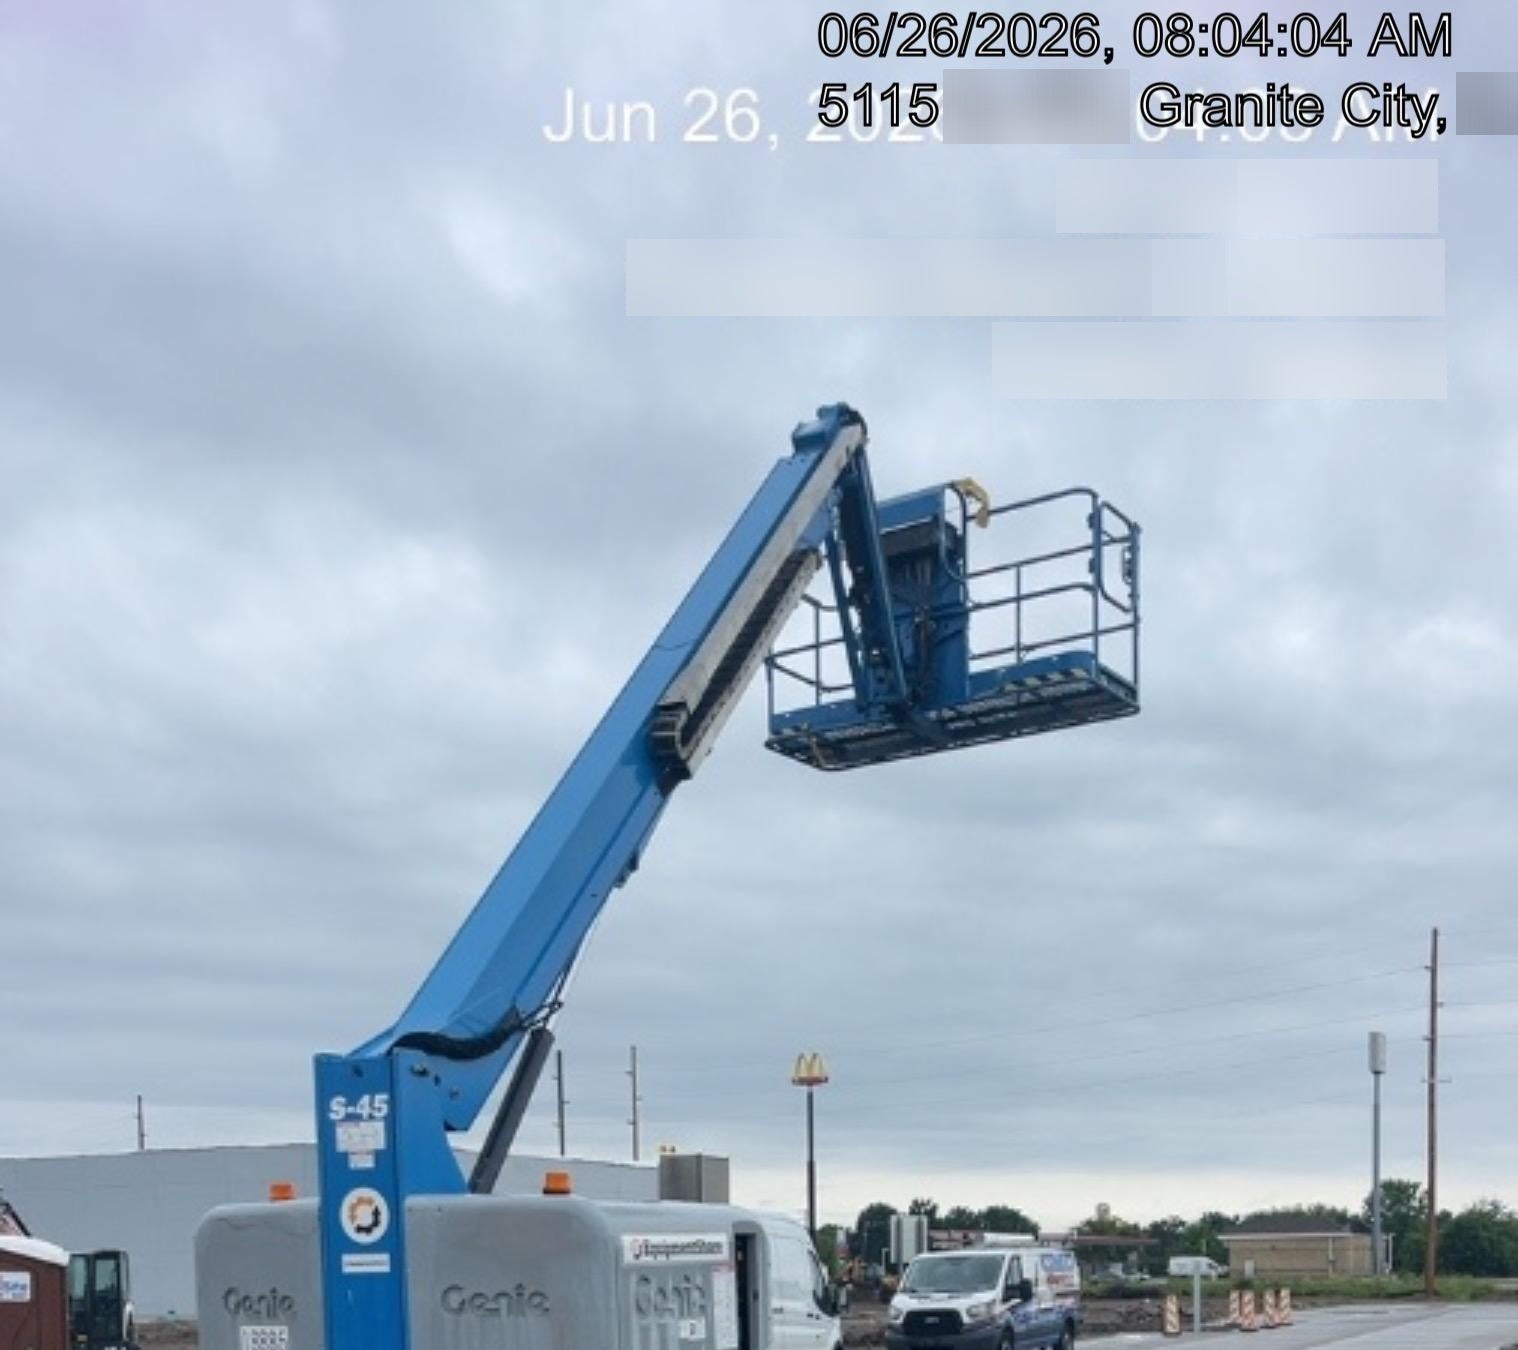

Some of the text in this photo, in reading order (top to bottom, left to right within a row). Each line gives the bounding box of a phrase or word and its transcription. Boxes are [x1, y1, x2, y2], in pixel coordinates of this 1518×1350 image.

[328, 1093, 390, 1121] S-45
[222, 1286, 297, 1318] Genie
[441, 1283, 550, 1318] Genie
